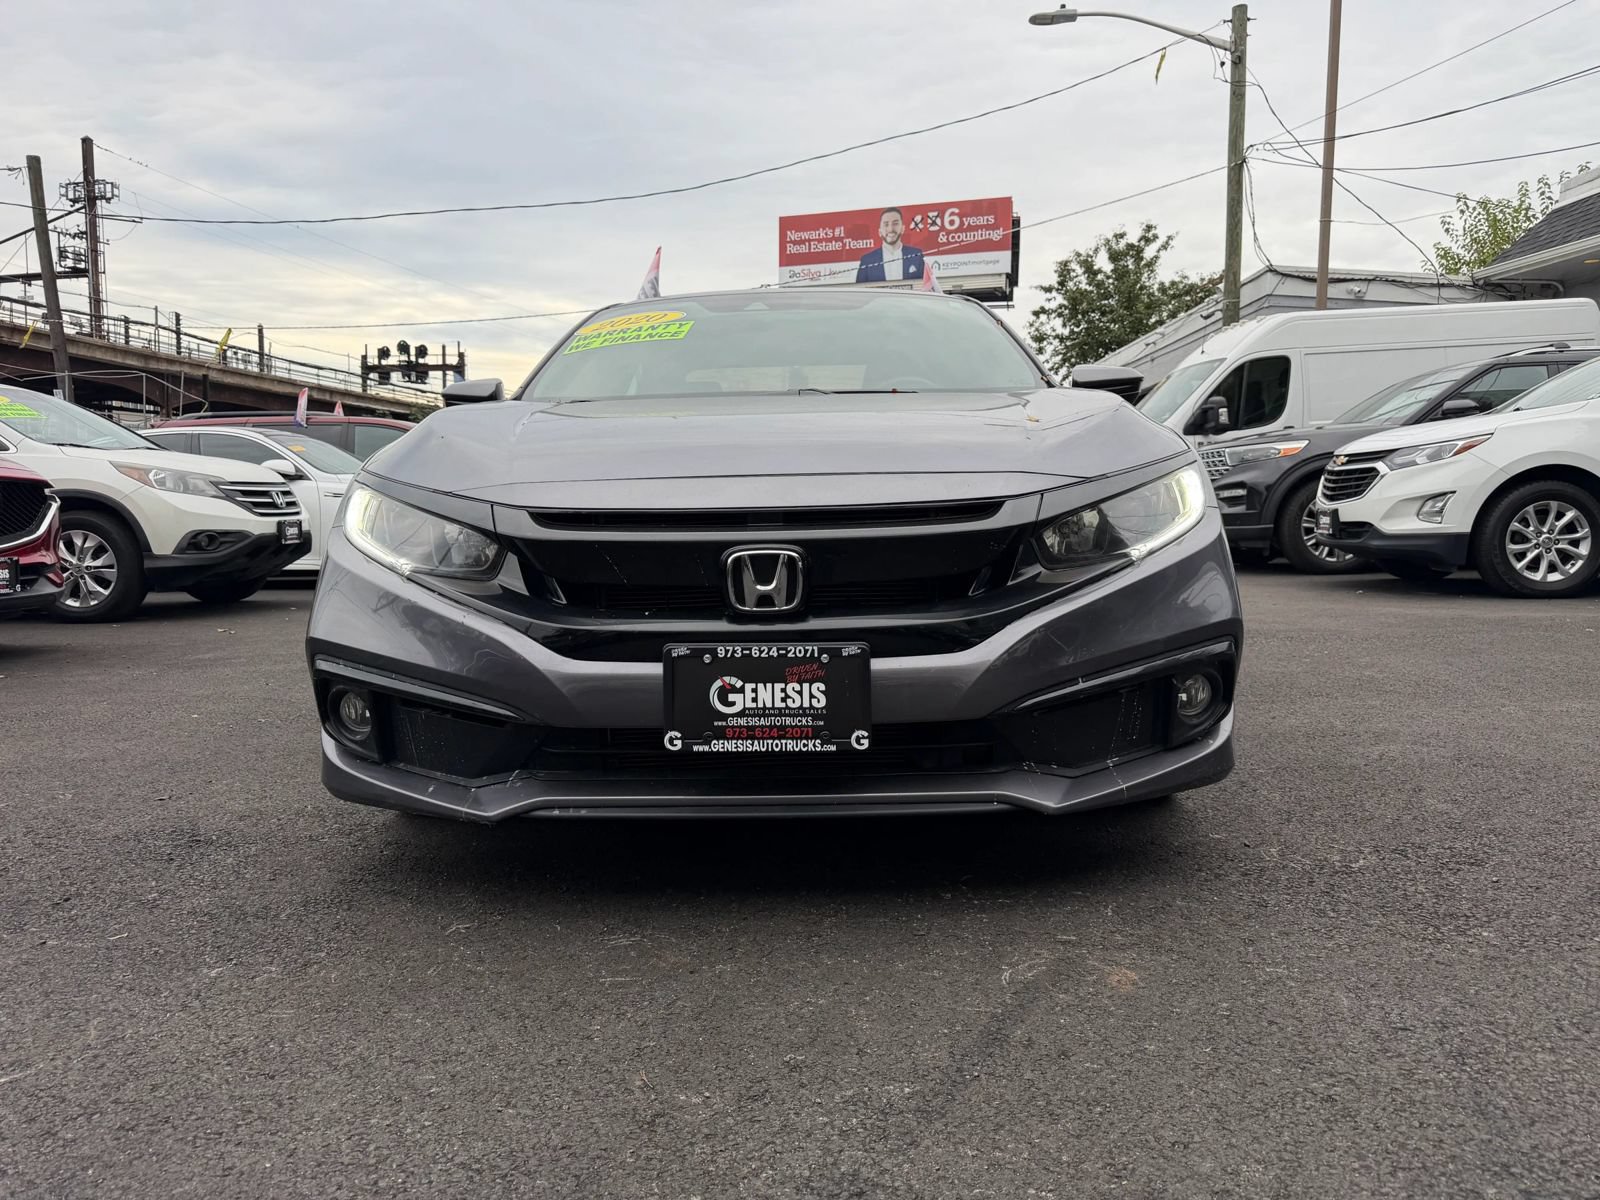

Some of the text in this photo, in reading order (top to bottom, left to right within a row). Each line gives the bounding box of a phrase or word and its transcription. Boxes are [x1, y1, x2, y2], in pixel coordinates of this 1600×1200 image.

[943, 207, 961, 230] 6
[962, 215, 995, 228] years
[786, 226, 845, 241] Newark's #1
[938, 227, 1003, 243] & counting!
[786, 239, 875, 254] Real Estate Team
[594, 313, 668, 331] 2020
[575, 321, 690, 343] WARRANTY
[567, 330, 685, 352] WE FINANCE
[717, 646, 819, 658] 973-624-2071
[709, 675, 827, 714] GENESIS
[725, 728, 813, 738] 973-624-2071
